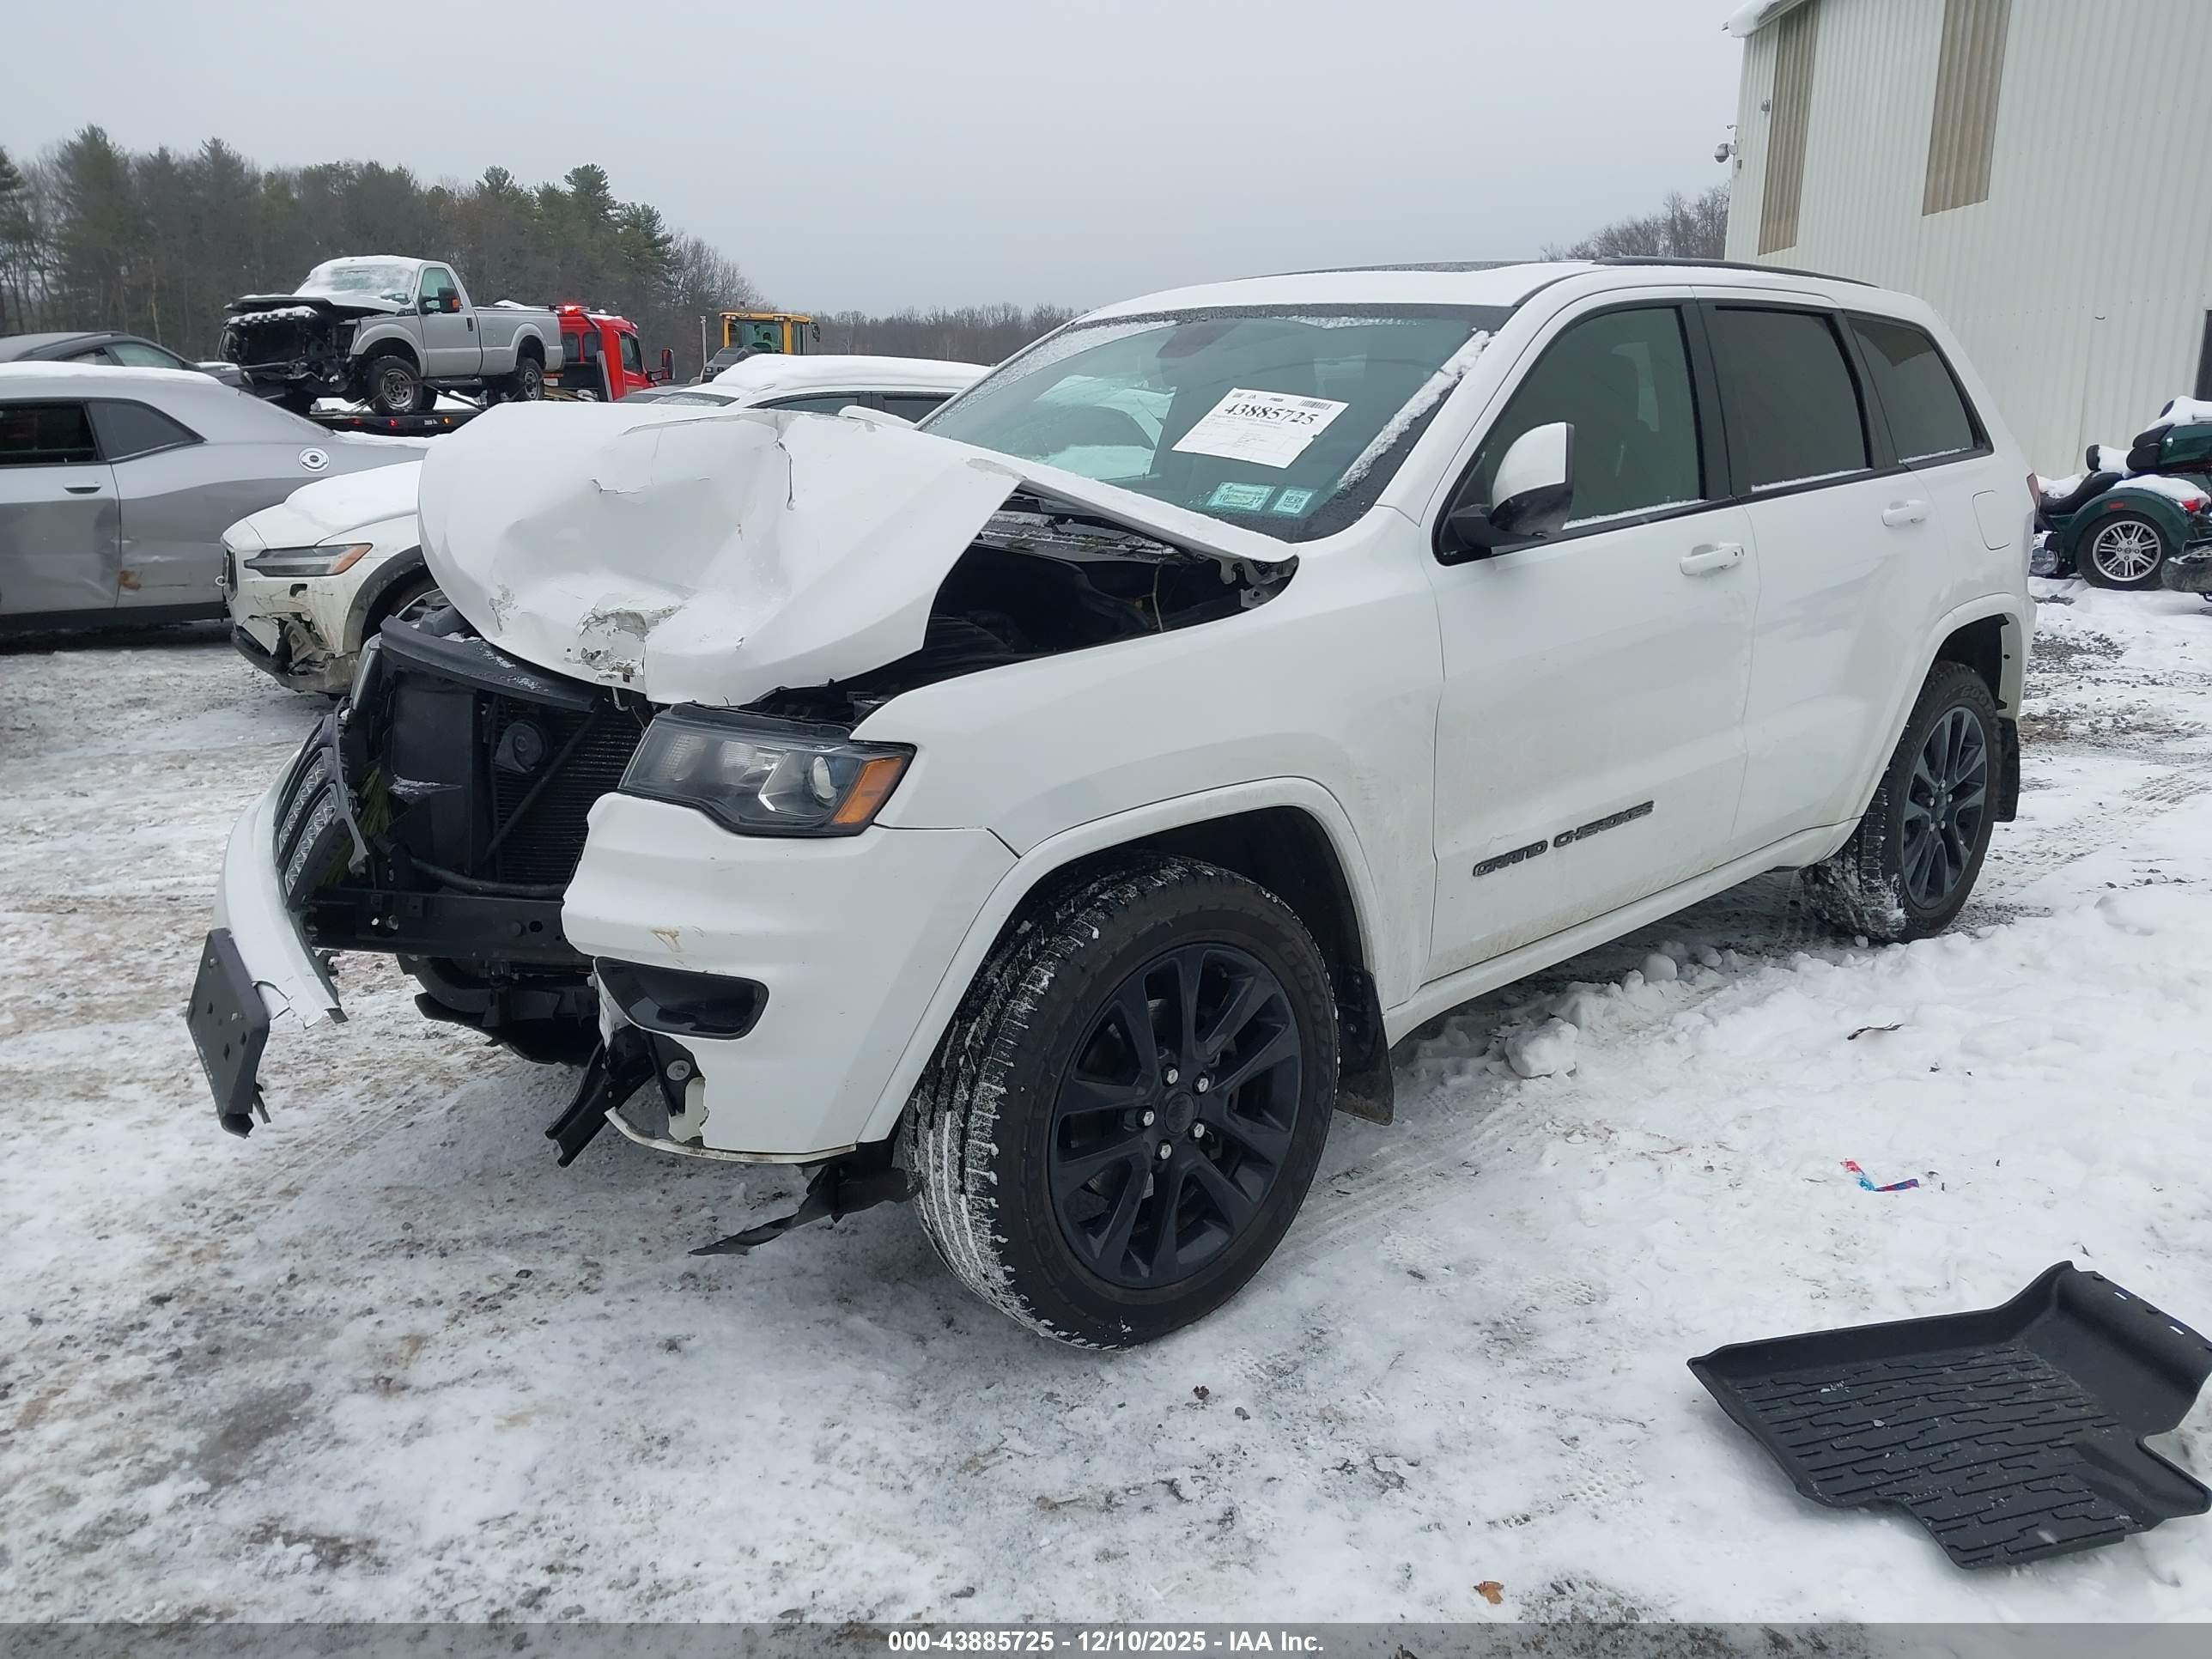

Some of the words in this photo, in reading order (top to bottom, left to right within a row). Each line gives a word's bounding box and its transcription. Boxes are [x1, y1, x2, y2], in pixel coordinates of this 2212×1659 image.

[1224, 402, 1319, 425] 43885725
[1472, 840, 1548, 877] GRAND
[1553, 799, 1655, 848] CHEROKEE
